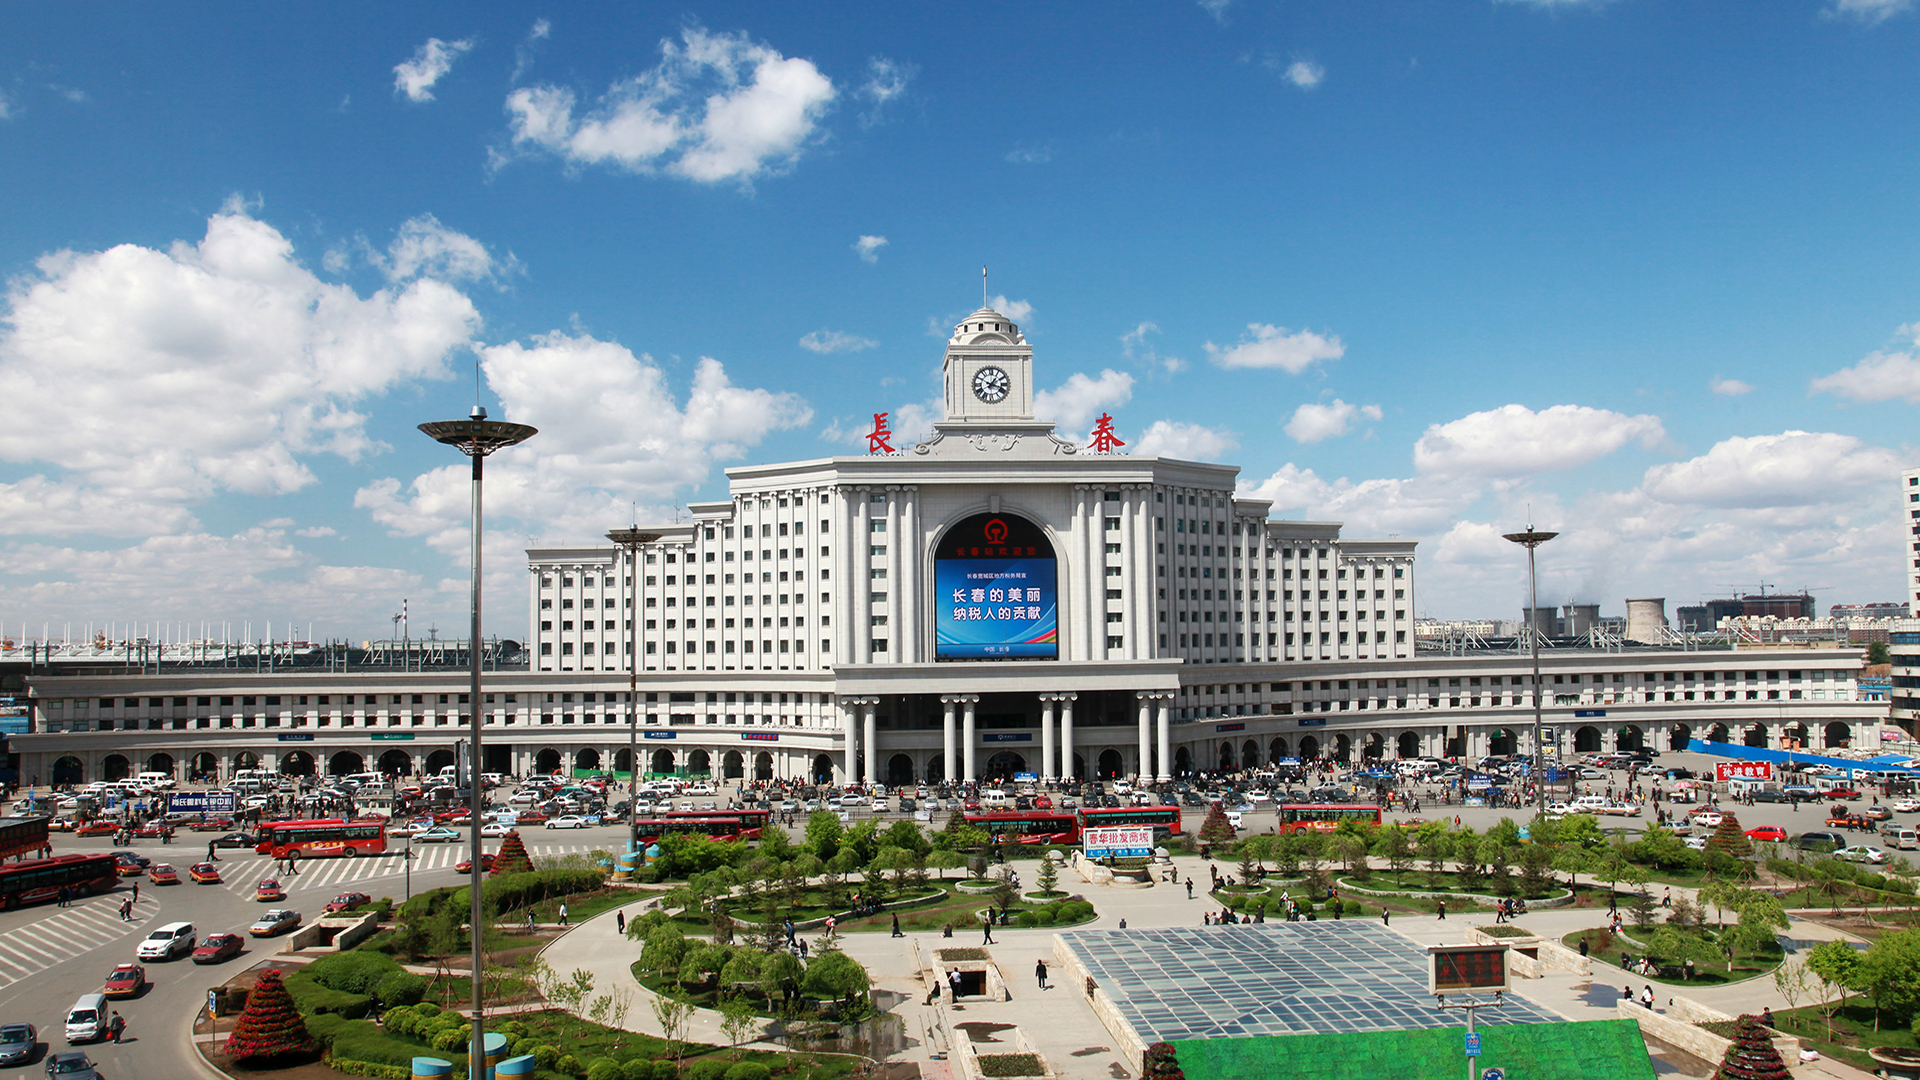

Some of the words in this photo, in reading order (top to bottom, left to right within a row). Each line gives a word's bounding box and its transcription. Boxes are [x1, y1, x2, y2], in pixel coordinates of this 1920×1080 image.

[865, 412, 896, 453] 長
[1087, 411, 1126, 452] 春
[956, 547, 1036, 556] 长春站欢迎您
[952, 587, 1041, 603] 长春的美丽
[953, 606, 1041, 621] 纳税人的贡献
[1089, 832, 1149, 844] 春华批发商城
